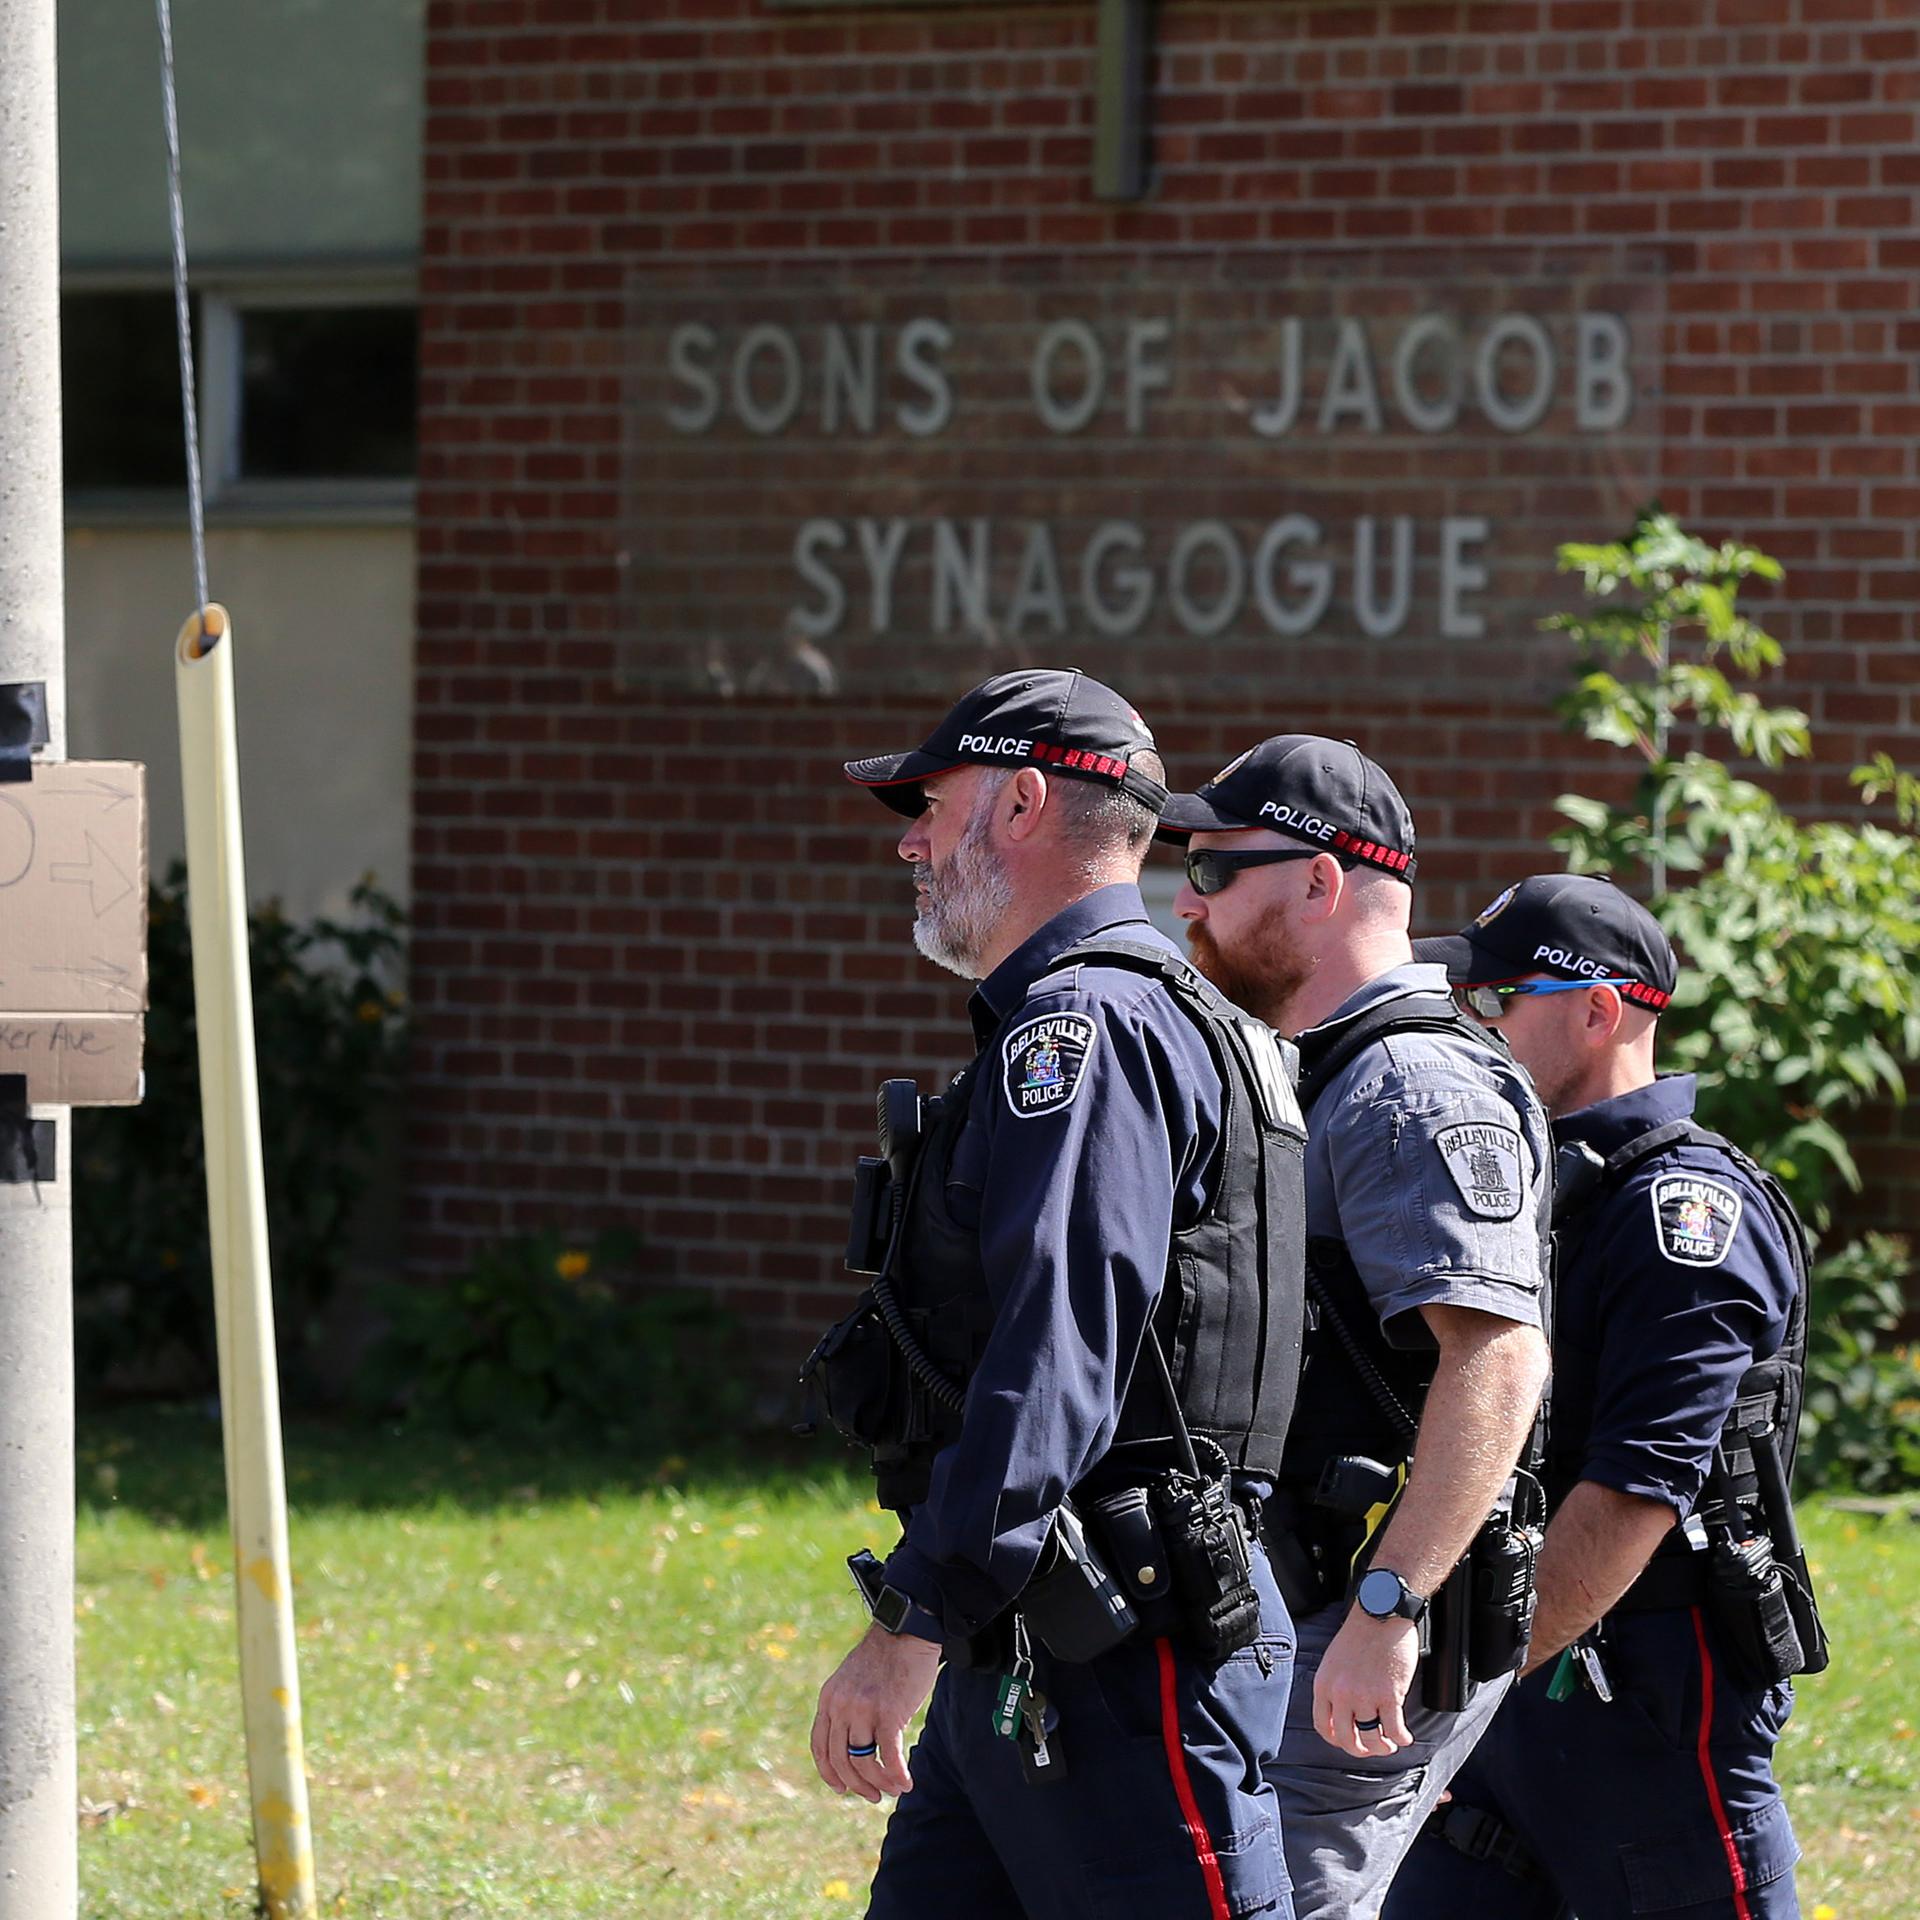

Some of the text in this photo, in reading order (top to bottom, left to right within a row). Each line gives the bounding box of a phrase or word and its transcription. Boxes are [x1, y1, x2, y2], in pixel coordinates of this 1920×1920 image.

[666, 311, 1631, 438] SONS OF JACOB
[794, 515, 1490, 638] SYNAGOGUE
[958, 734, 1033, 756] POLICE
[1259, 801, 1337, 841] POLICE
[1533, 945, 1611, 980] POLICE
[49, 1020, 115, 1055] Ave
[1010, 1019, 1089, 1064] BELLEVILLE
[1022, 1082, 1065, 1107] POLICE
[1444, 1127, 1517, 1158] BELLEVILLE
[1472, 1191, 1512, 1208] POLICE
[1659, 1181, 1736, 1222] BELLEVILLE
[1673, 1236, 1716, 1256] POLICE
